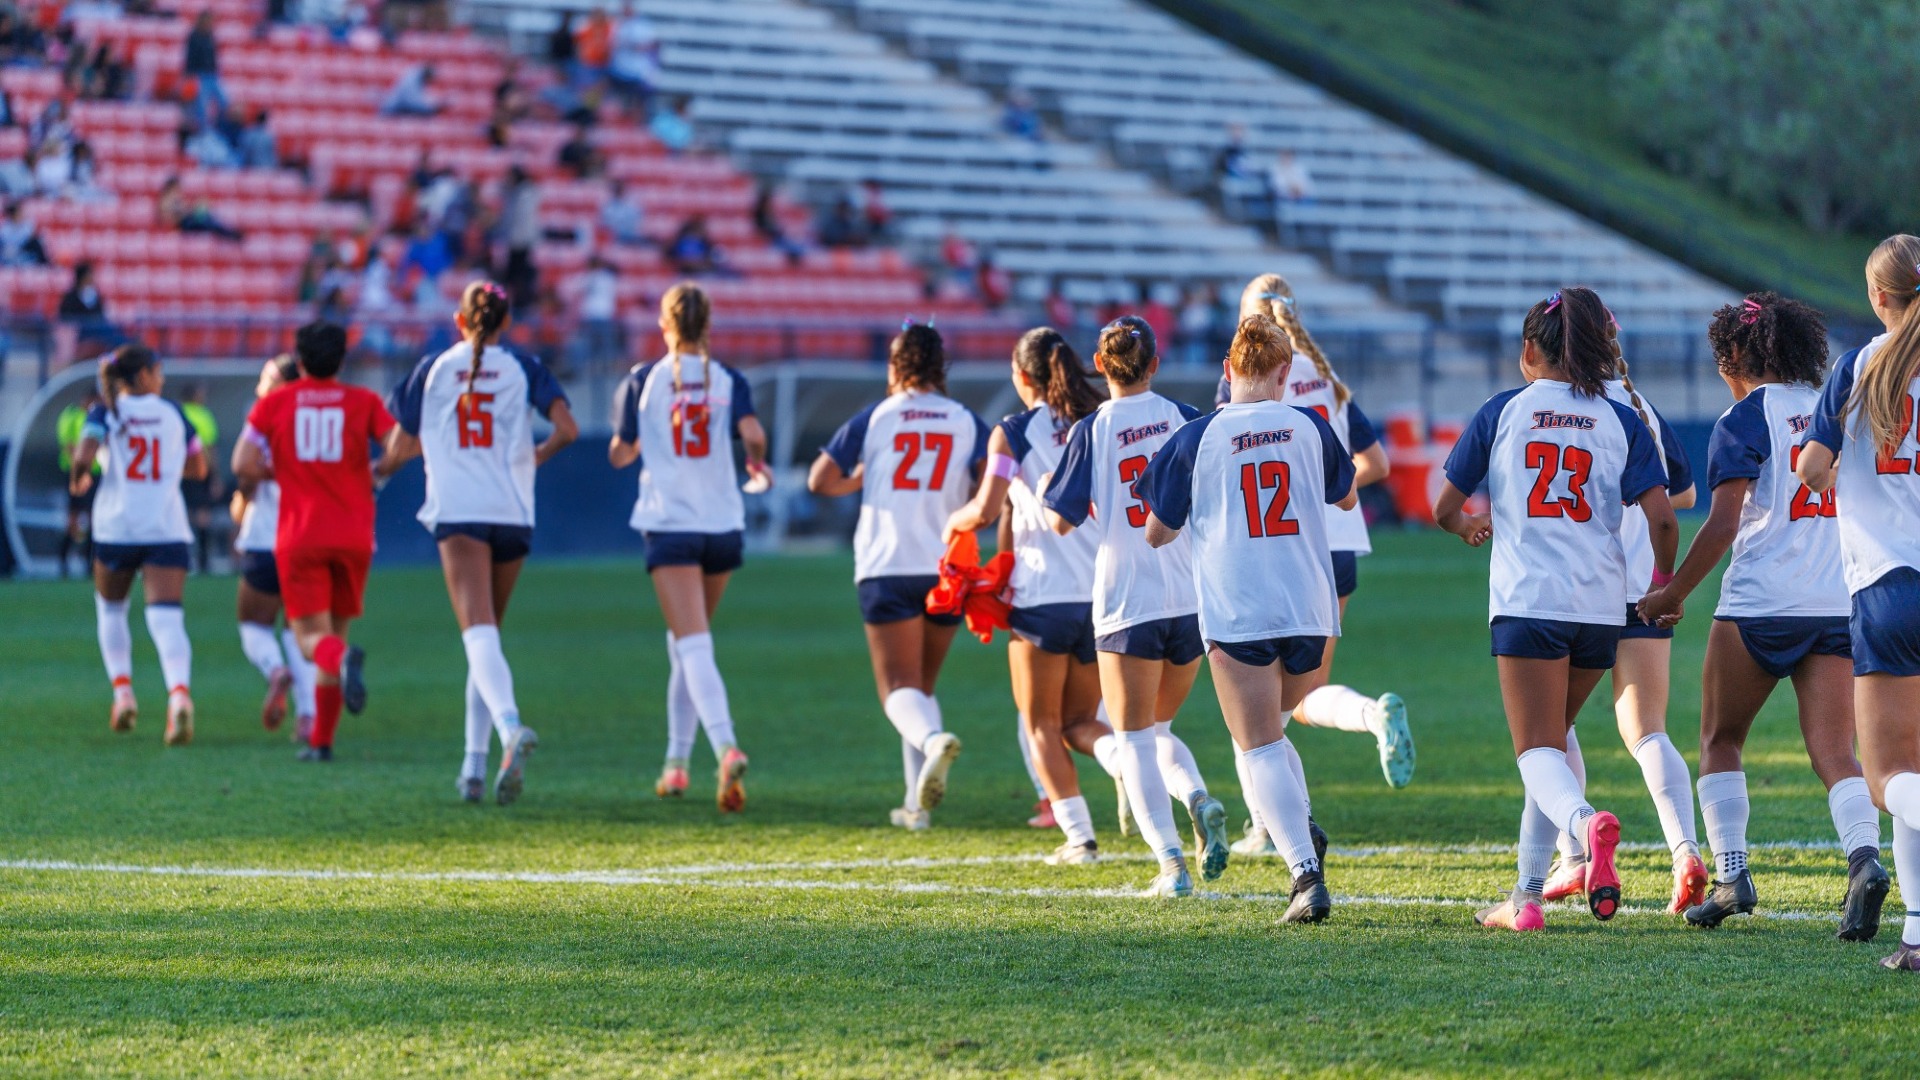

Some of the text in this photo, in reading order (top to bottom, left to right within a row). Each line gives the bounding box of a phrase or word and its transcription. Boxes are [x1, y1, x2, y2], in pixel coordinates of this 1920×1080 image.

[294, 407, 344, 462] 00
[456, 392, 494, 449] 15
[1116, 421, 1169, 449] TITANS
[1232, 429, 1293, 455] TITANS
[1530, 410, 1596, 430] TITANS
[126, 436, 160, 481] 21
[893, 432, 952, 490] 27
[1525, 441, 1592, 522] 23
[1118, 453, 1158, 528] 3
[1239, 460, 1299, 538] 12
